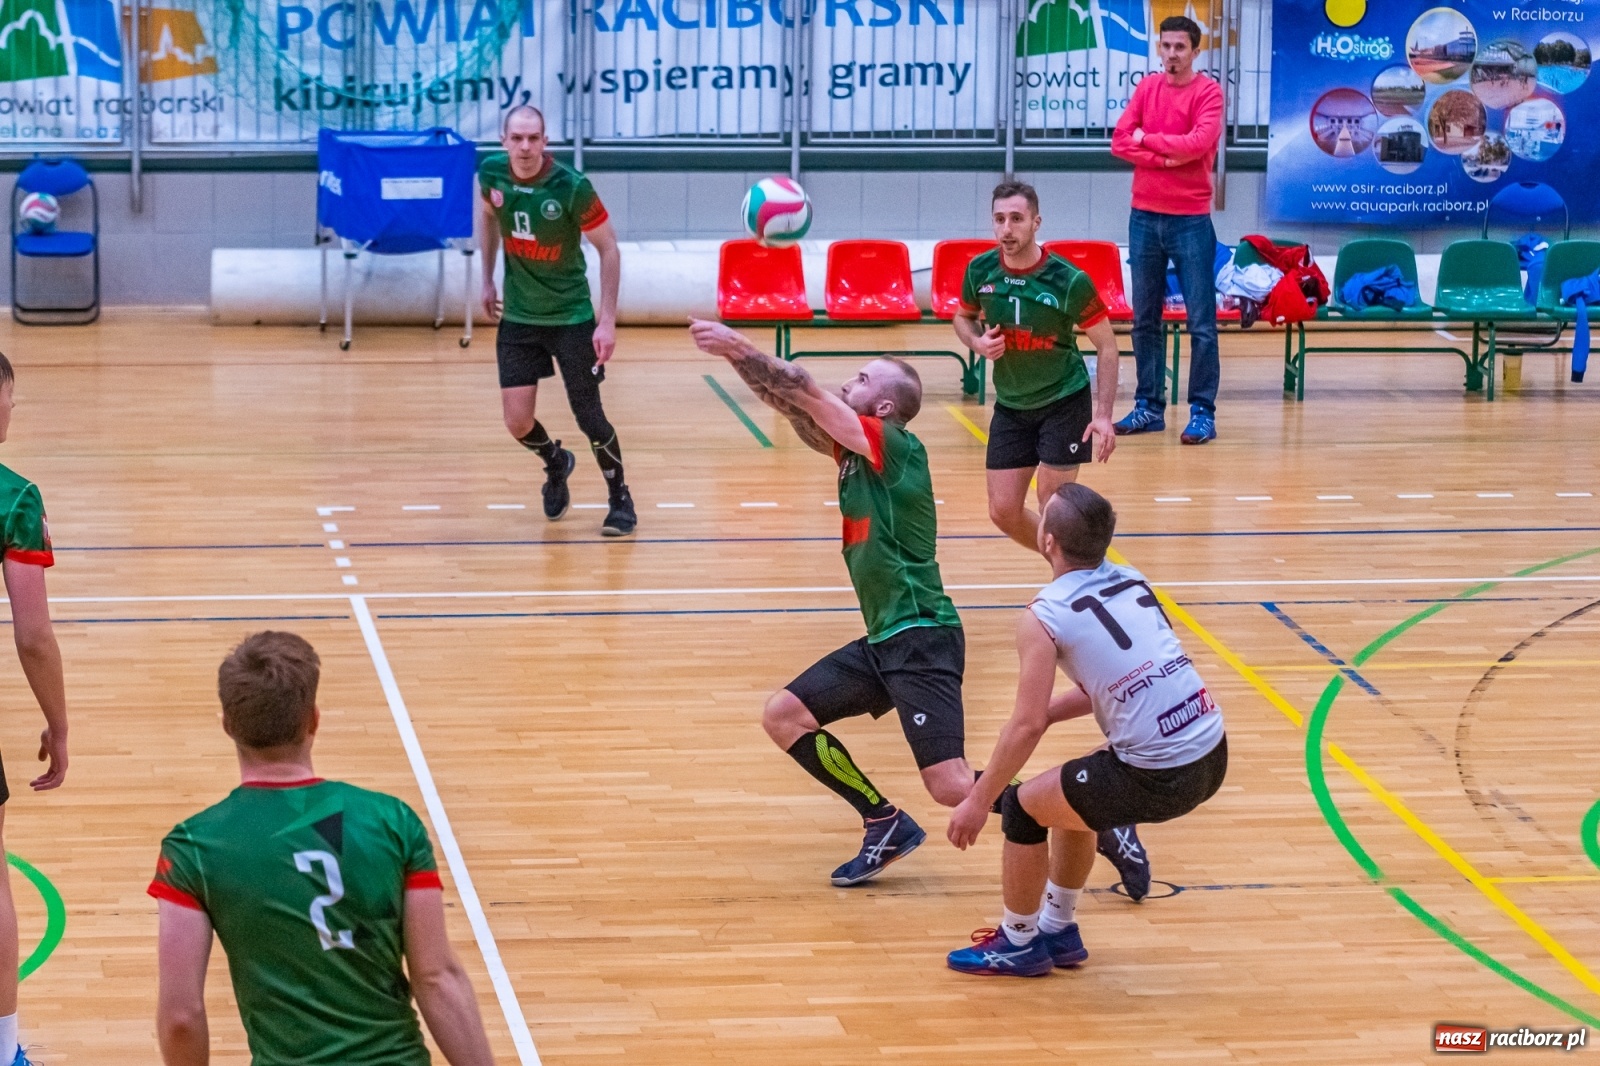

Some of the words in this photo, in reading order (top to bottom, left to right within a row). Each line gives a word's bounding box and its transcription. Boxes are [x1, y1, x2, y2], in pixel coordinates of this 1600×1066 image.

[571, 0, 966, 34] RACIBORSKI
[1492, 10, 1506, 20] w
[1511, 8, 1584, 22] Raciborzu
[0, 92, 73, 116] owiat
[93, 89, 224, 115] racborski
[274, 72, 532, 115] kibicujemy,
[828, 61, 971, 99] gramy
[1312, 183, 1448, 196] www.osir-raciborz.pl
[1311, 199, 1489, 213] www.aquapark.raciborz.pl
[514, 211, 531, 235] 13
[1008, 296, 1020, 326] 7
[1071, 579, 1173, 650] 17
[1107, 660, 1154, 694] RADIO
[1114, 653, 1192, 704] VANES
[292, 850, 355, 951] 2
